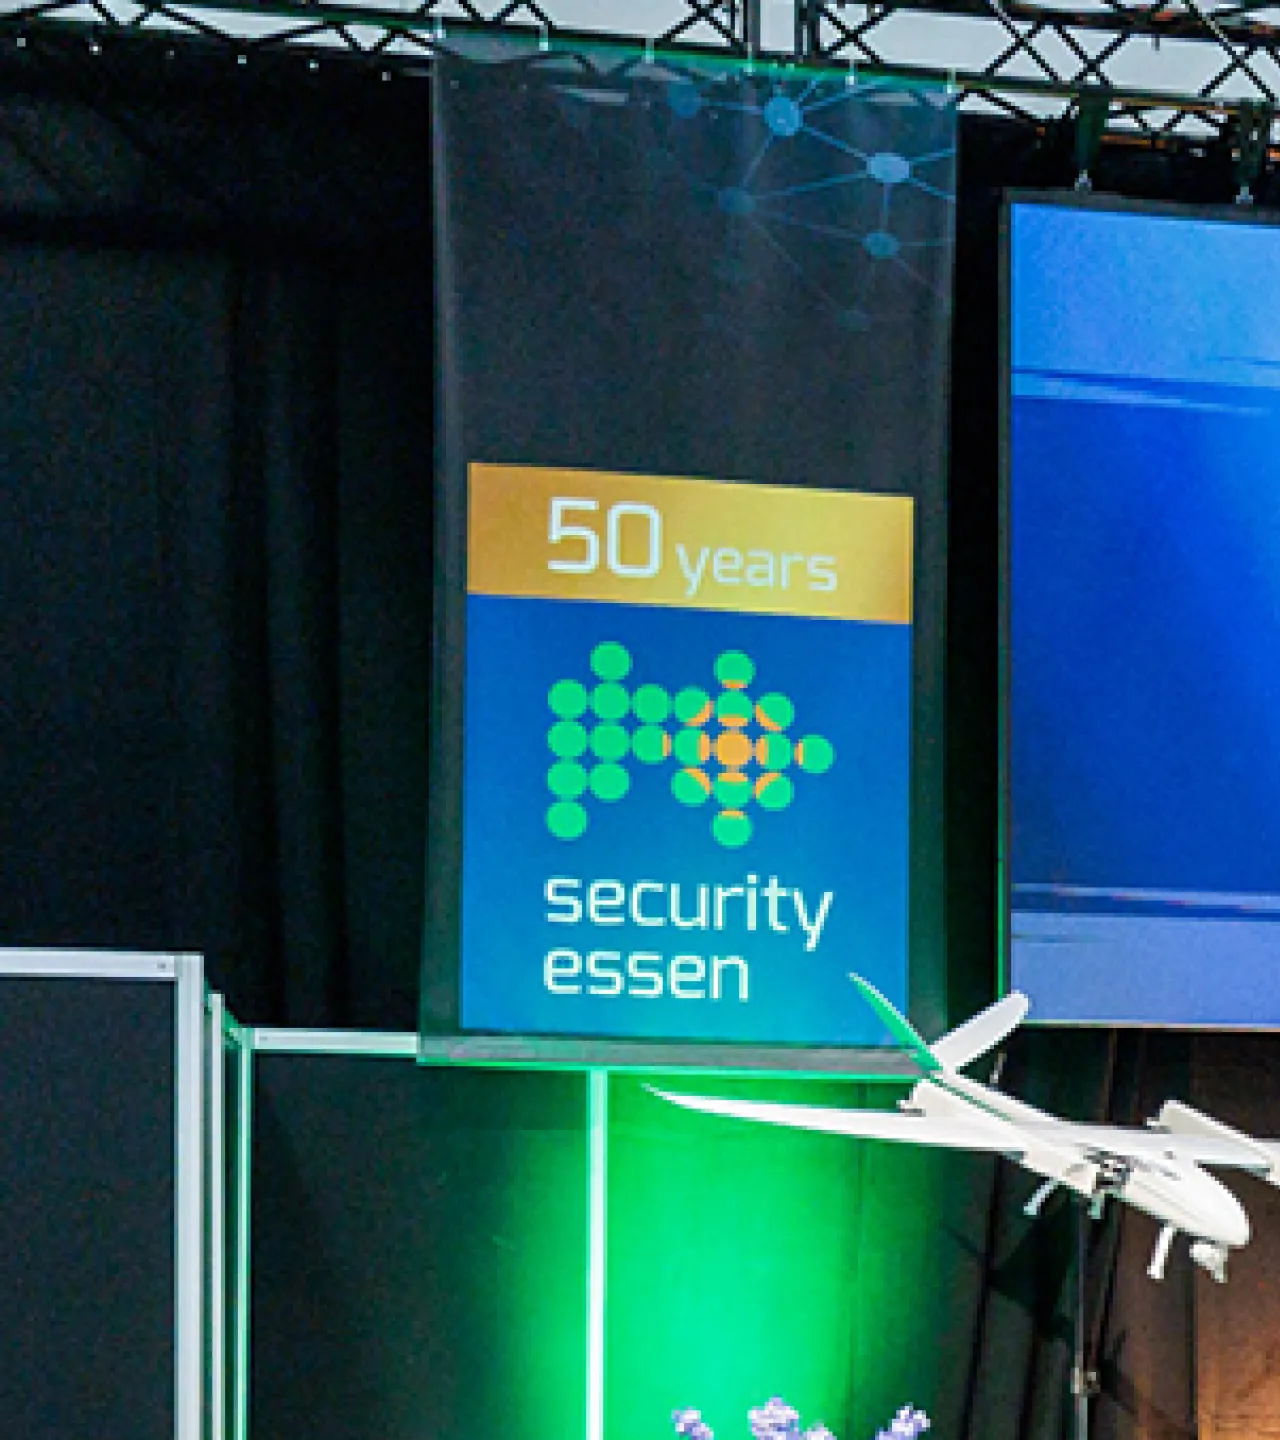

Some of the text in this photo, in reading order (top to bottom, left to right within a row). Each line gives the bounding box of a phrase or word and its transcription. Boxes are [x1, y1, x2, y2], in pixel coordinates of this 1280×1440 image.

[548, 497, 838, 597] 50 years
[544, 873, 834, 951] security
[543, 948, 749, 1002] essen
